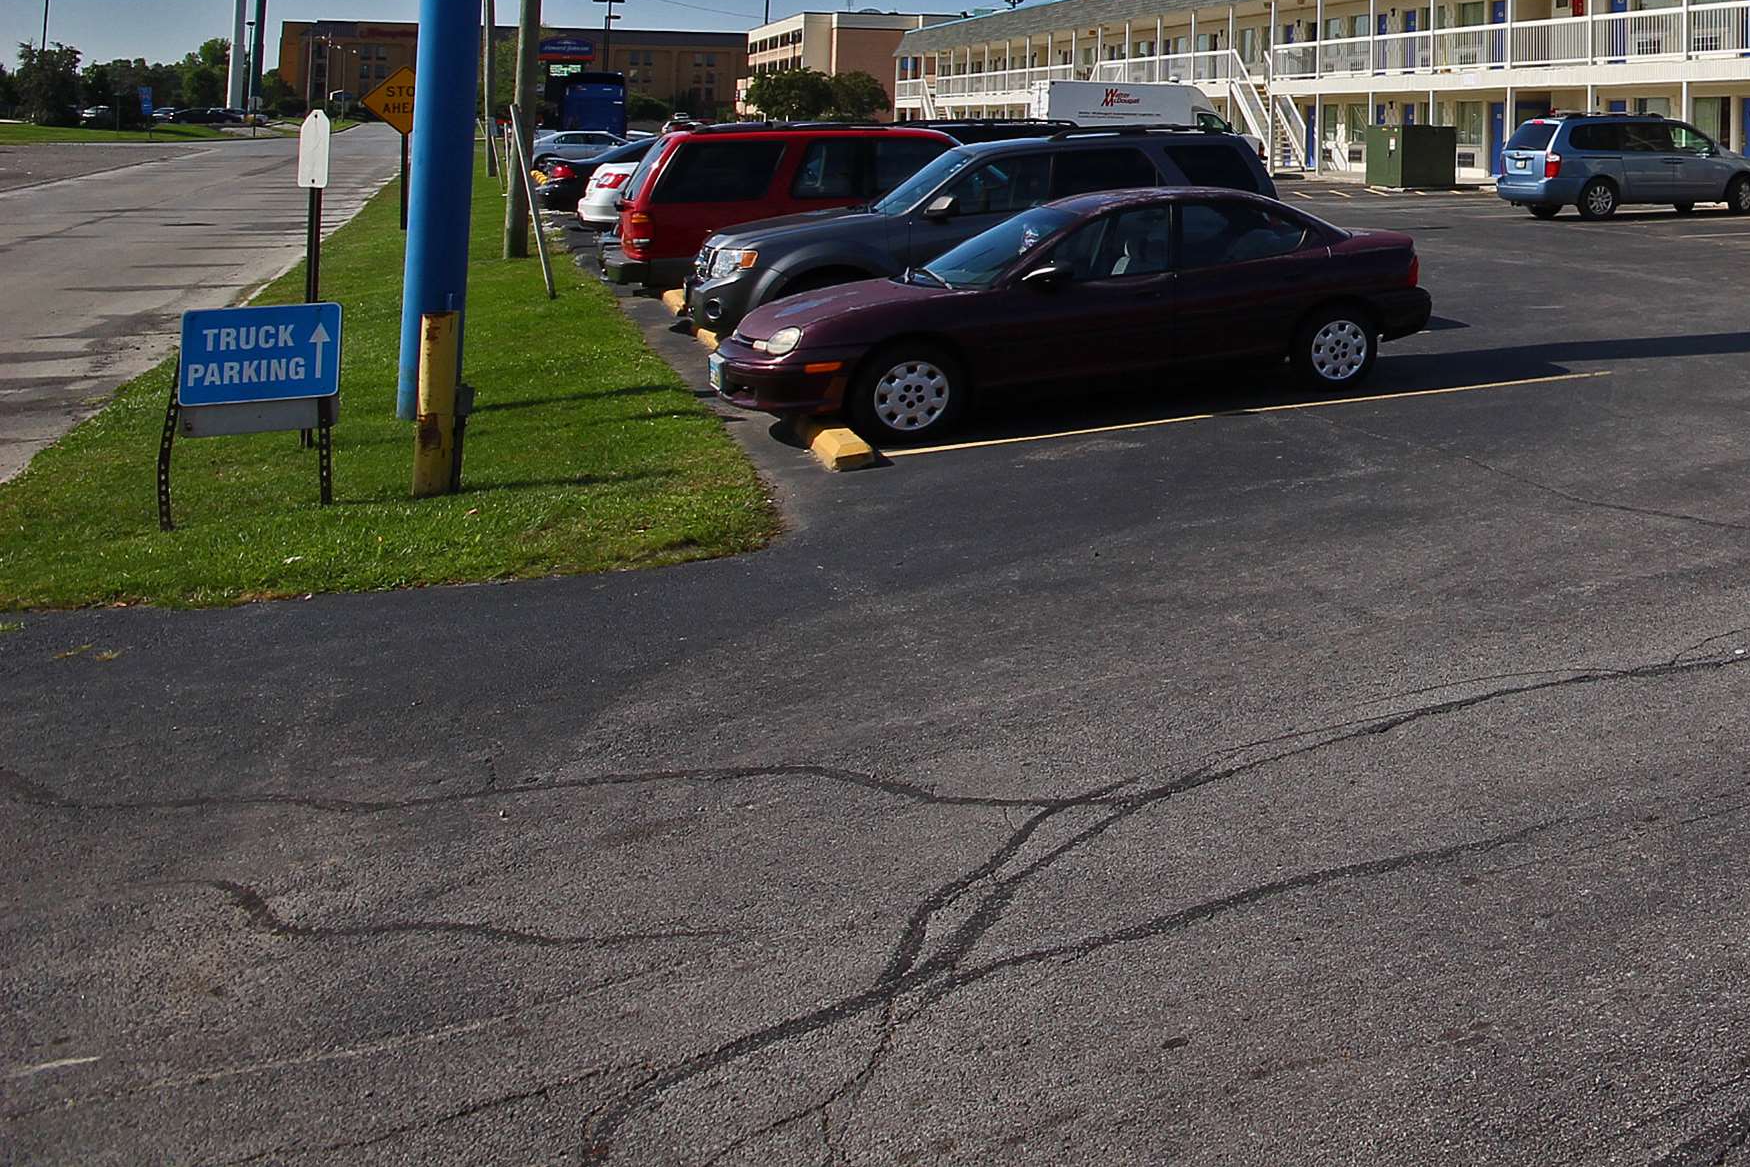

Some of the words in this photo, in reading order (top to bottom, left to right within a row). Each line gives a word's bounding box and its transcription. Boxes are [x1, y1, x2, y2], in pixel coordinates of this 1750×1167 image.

[386, 86, 415, 97] STO
[203, 324, 295, 352] TRUCK
[187, 357, 306, 387] PARKING
